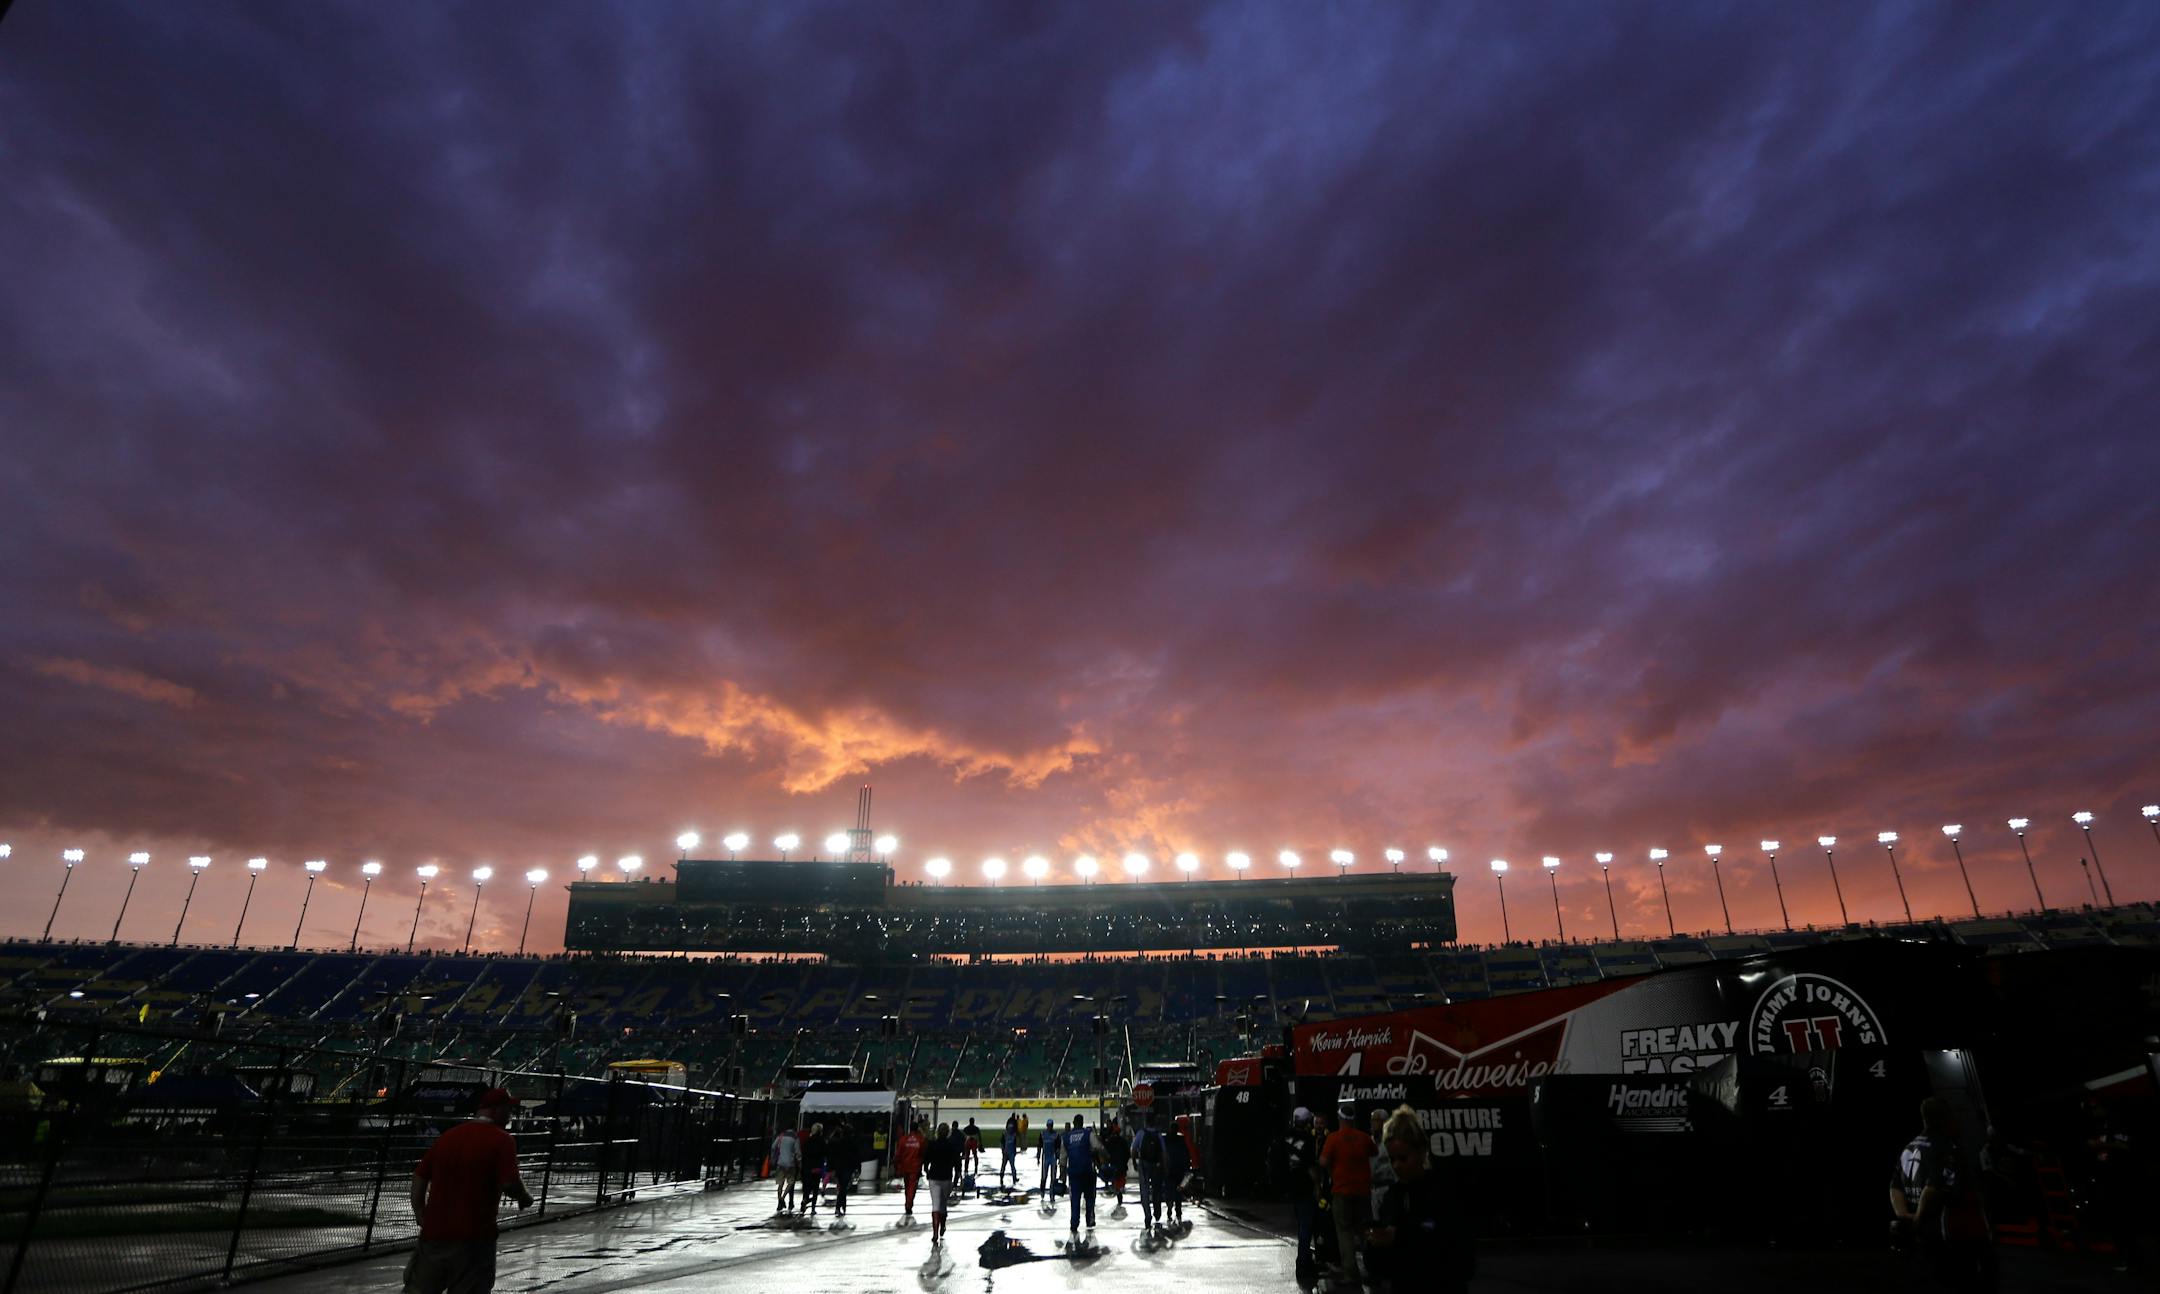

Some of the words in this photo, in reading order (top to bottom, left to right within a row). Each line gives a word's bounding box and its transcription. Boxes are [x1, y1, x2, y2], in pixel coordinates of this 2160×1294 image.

[1757, 985, 1798, 1054] JIMMY
[1805, 983, 1877, 1045] JOHN'S
[1311, 1031, 1342, 1053] Kevin
[1343, 1025, 1392, 1050] Harvick
[1621, 1020, 1740, 1058] FREAKY
[1385, 1049, 1570, 1094] Budweiser
[1867, 1059, 1888, 1079] 4
[1133, 1089, 1155, 1102] STOP
[1235, 1090, 1250, 1104] 48
[1338, 1082, 1409, 1101] Hendrick
[1607, 1083, 1688, 1116] Hendric
[1767, 1085, 1789, 1105] 4
[1416, 1107, 1504, 1130] RNITURE
[1430, 1131, 1494, 1157] OW
